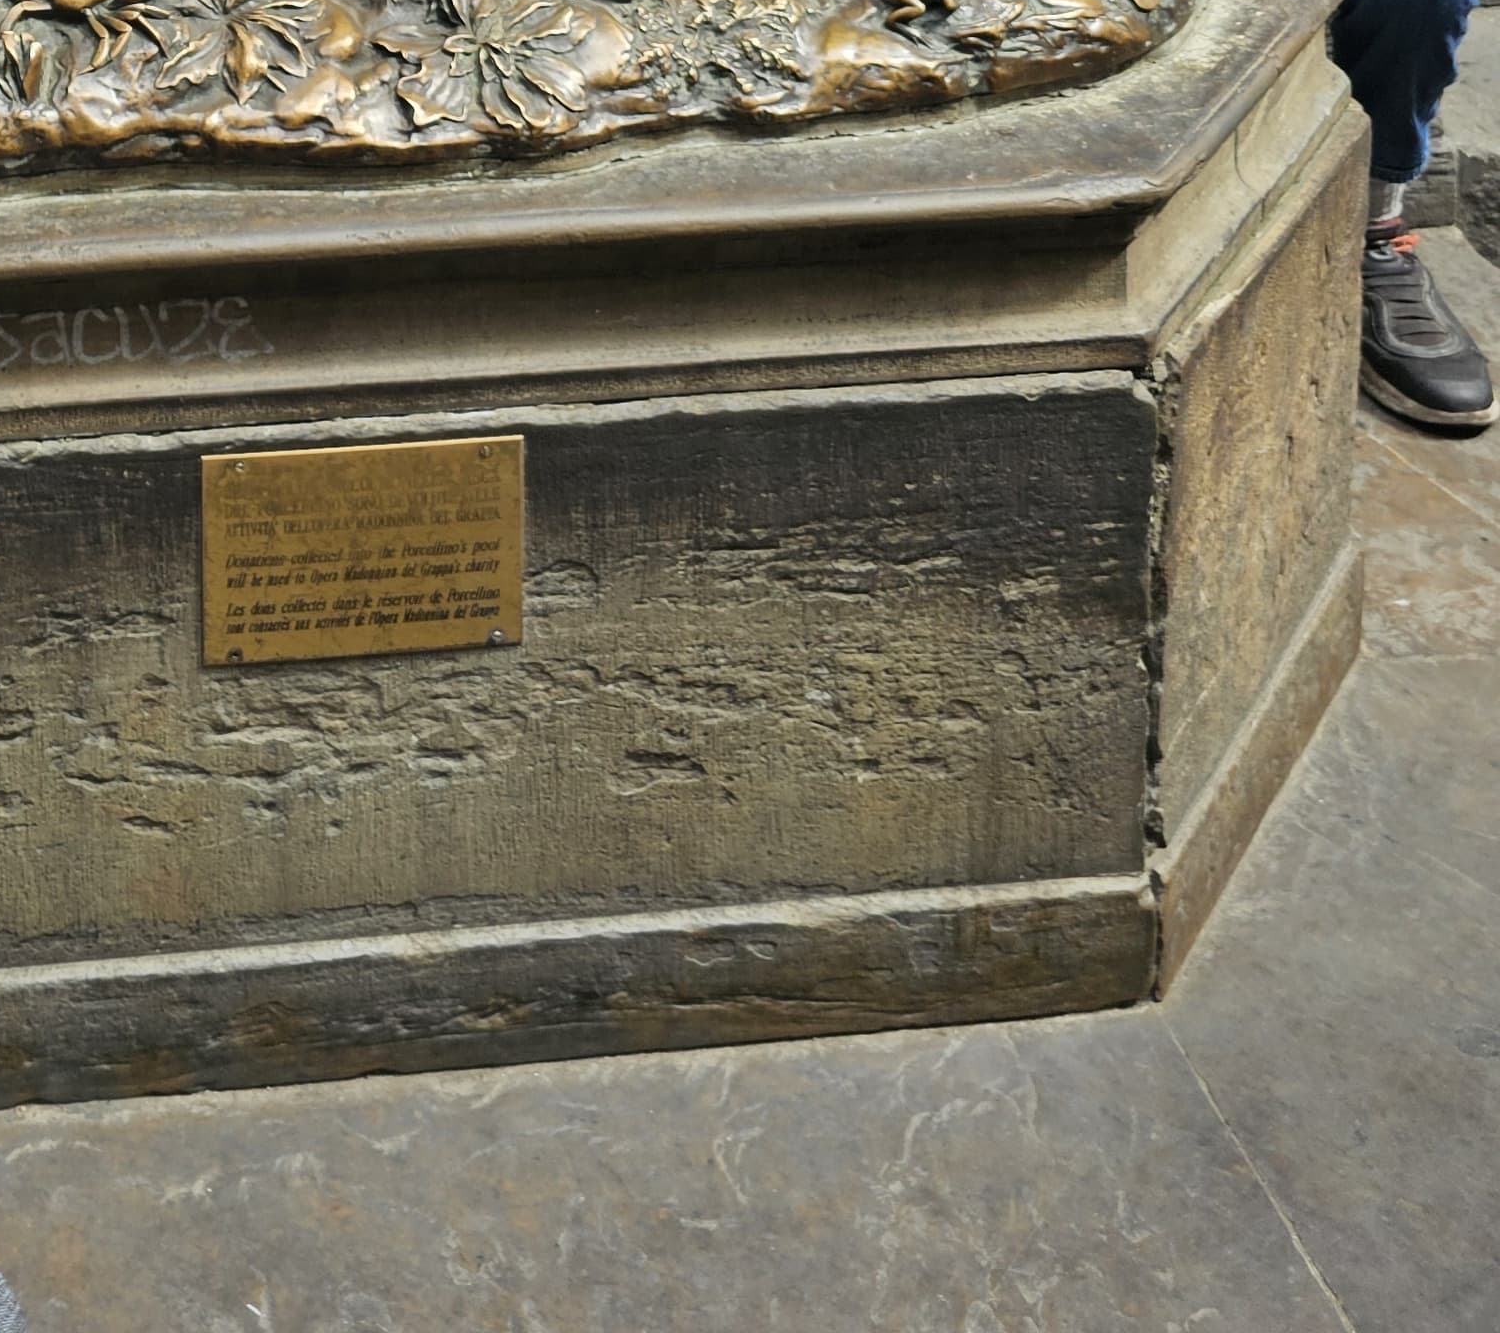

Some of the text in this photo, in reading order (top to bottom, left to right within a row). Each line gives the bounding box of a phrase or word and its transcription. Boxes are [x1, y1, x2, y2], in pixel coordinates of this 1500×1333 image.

[290, 548, 343, 565] collected
[471, 537, 500, 555] pool
[227, 573, 246, 588] will
[310, 570, 338, 586] Opera
[465, 558, 500, 574] charity
[226, 603, 245, 617] Les
[251, 601, 276, 615] dons
[332, 597, 358, 611] dans
[429, 589, 443, 604] de
[447, 586, 500, 603] Porcellino
